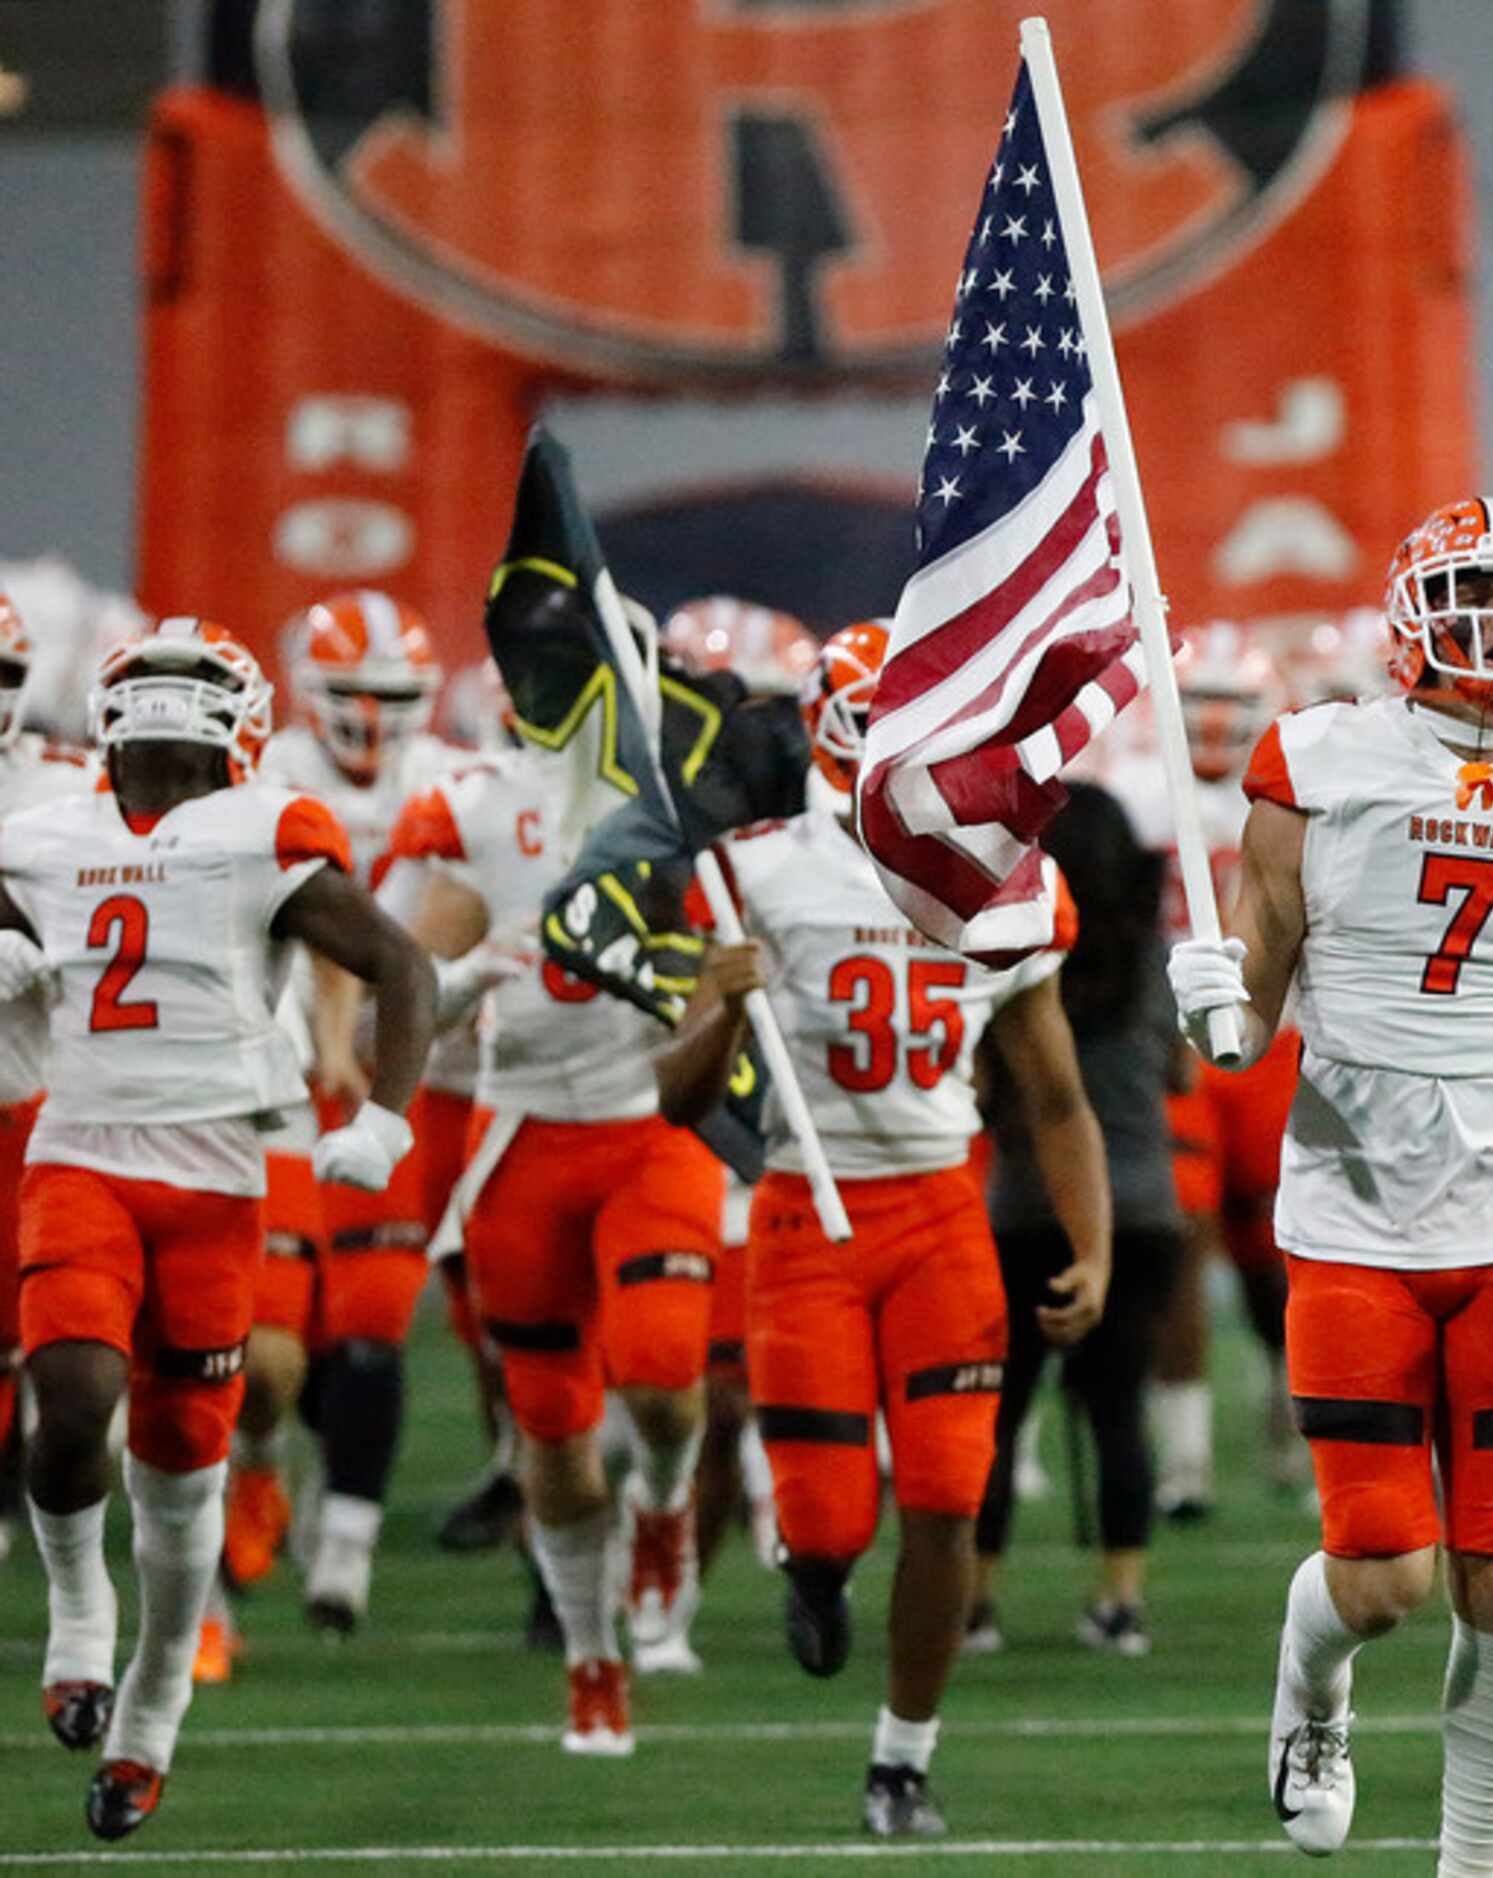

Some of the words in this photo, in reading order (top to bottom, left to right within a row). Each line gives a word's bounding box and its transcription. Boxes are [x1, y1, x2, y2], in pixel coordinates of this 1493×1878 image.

[516, 808, 543, 858] C
[86, 893, 159, 1033] 2
[828, 954, 966, 1093] 35
